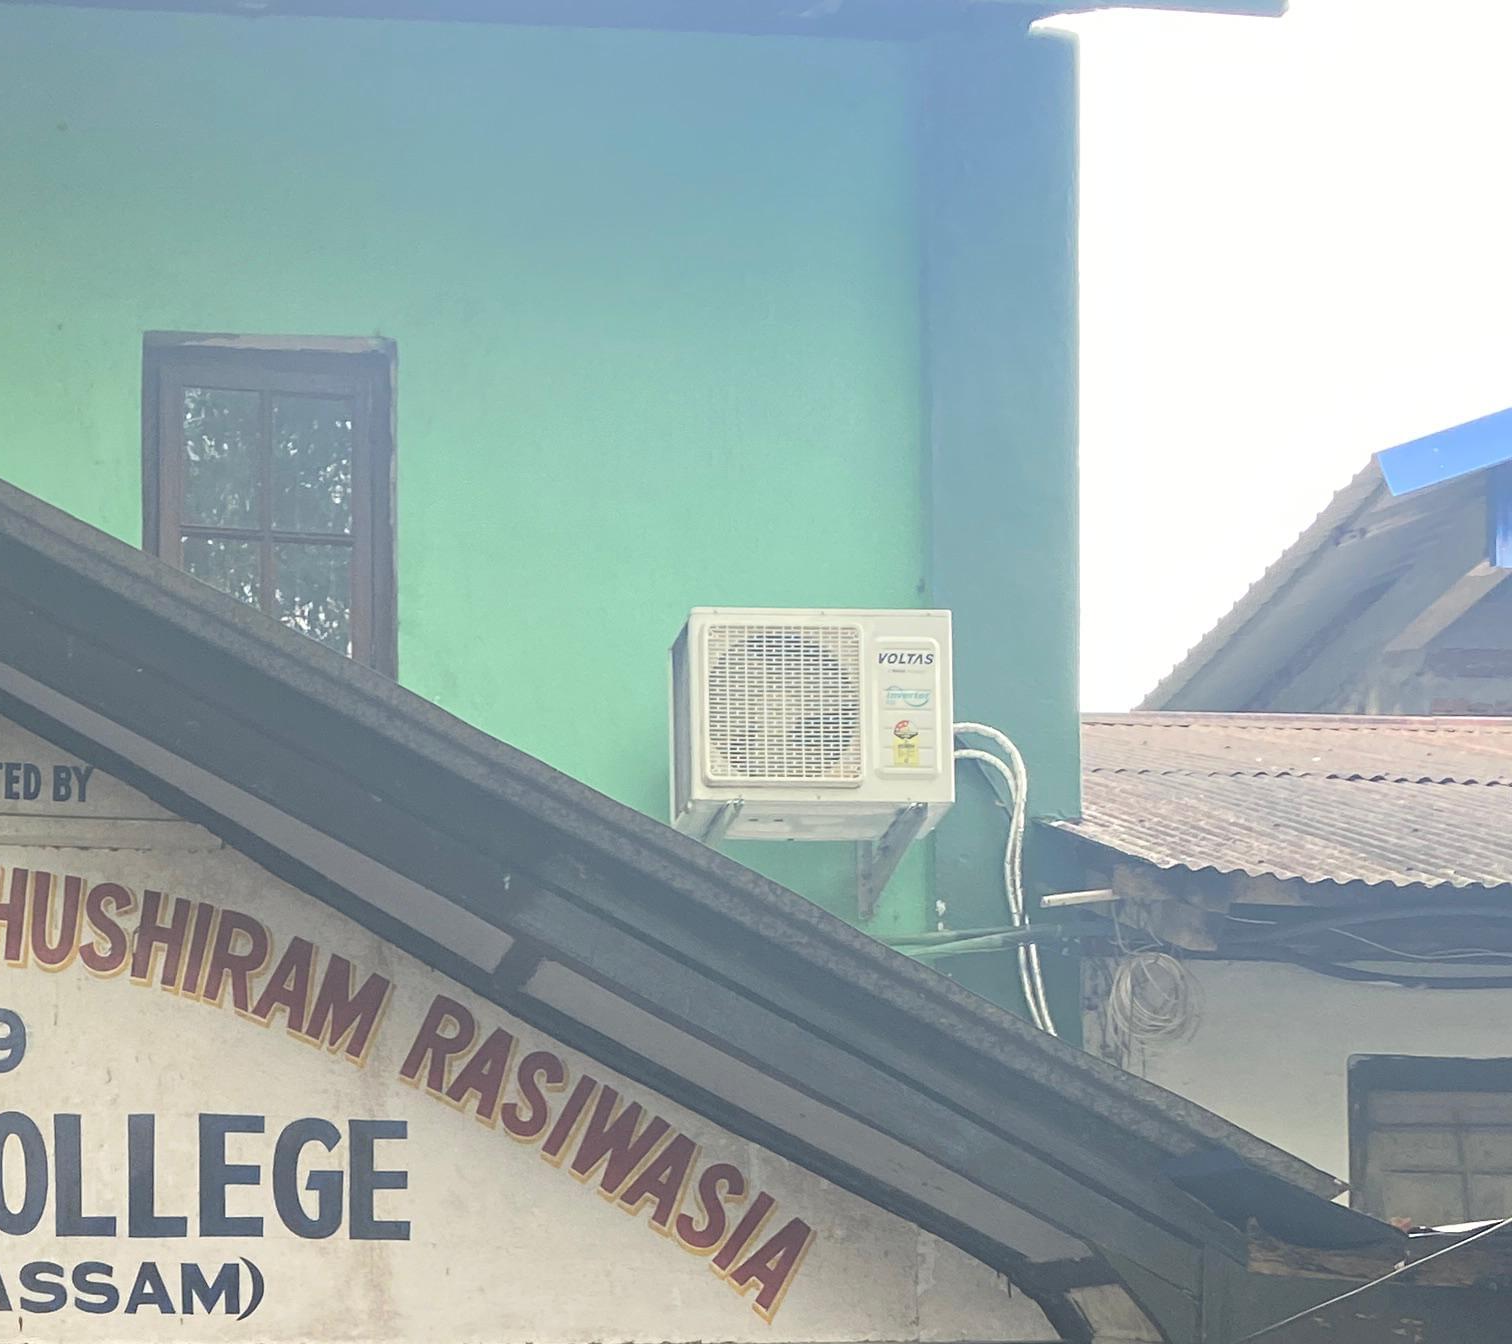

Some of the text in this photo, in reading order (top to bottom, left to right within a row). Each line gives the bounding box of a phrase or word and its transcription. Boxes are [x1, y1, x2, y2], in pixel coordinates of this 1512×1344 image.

[877, 652, 934, 665] VOLTAS
[53, 764, 94, 802] BY
[400, 993, 818, 1325] RASIWASIA
